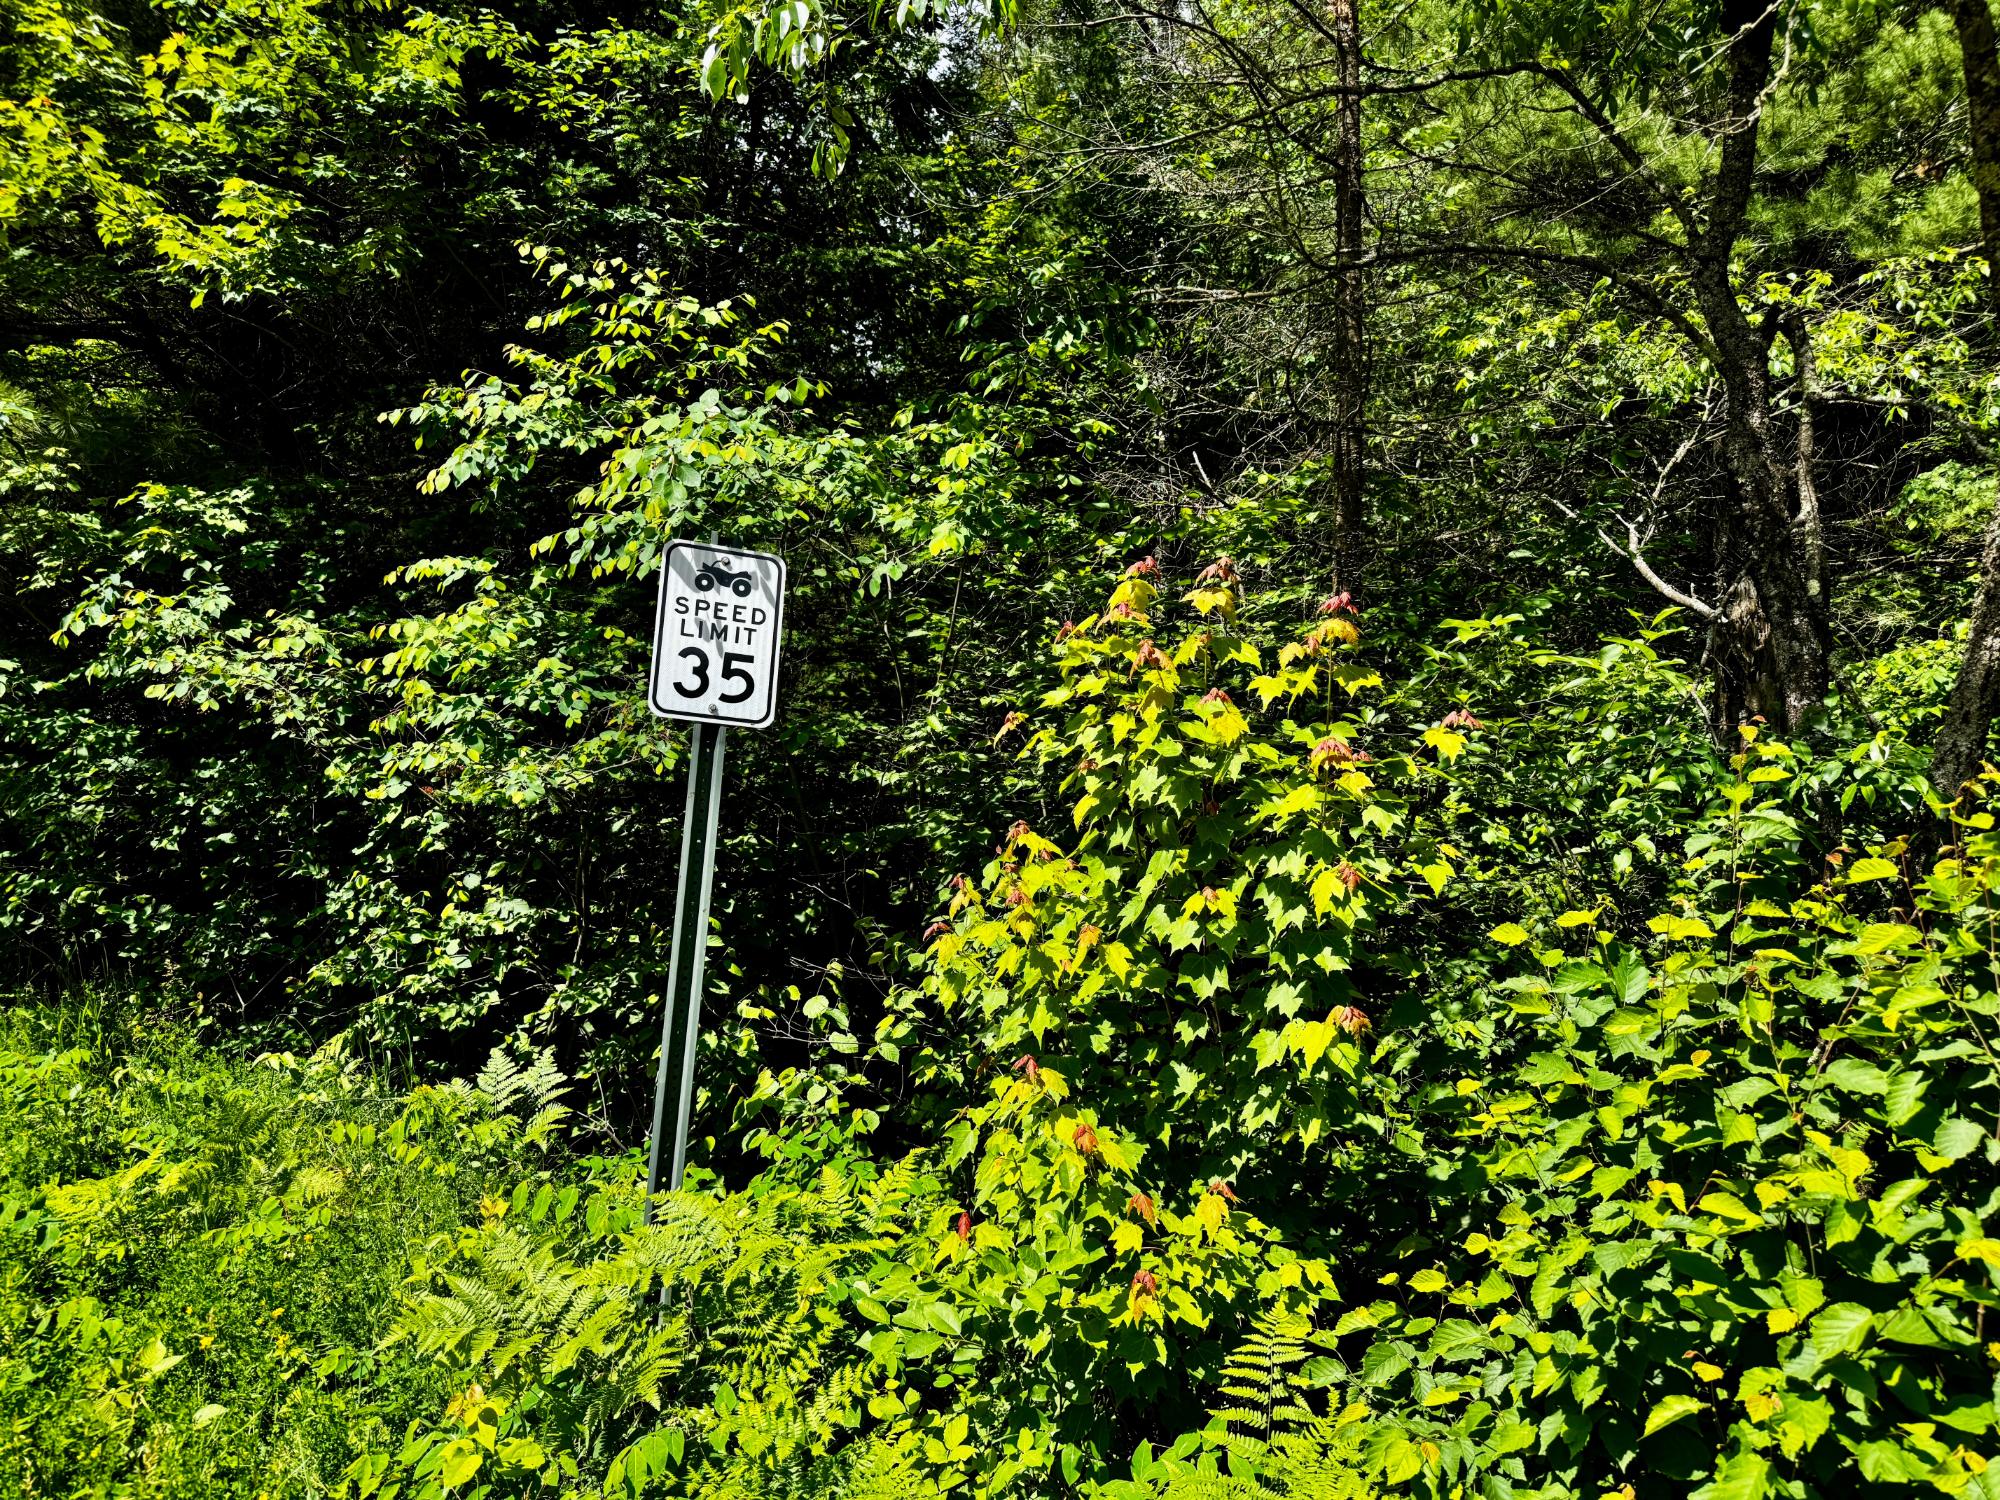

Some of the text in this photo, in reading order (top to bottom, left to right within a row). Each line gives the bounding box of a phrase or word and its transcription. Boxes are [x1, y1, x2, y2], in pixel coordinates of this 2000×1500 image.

[674, 596, 767, 626] SPEED
[680, 618, 757, 646] LIMIT
[673, 646, 755, 704] 35
